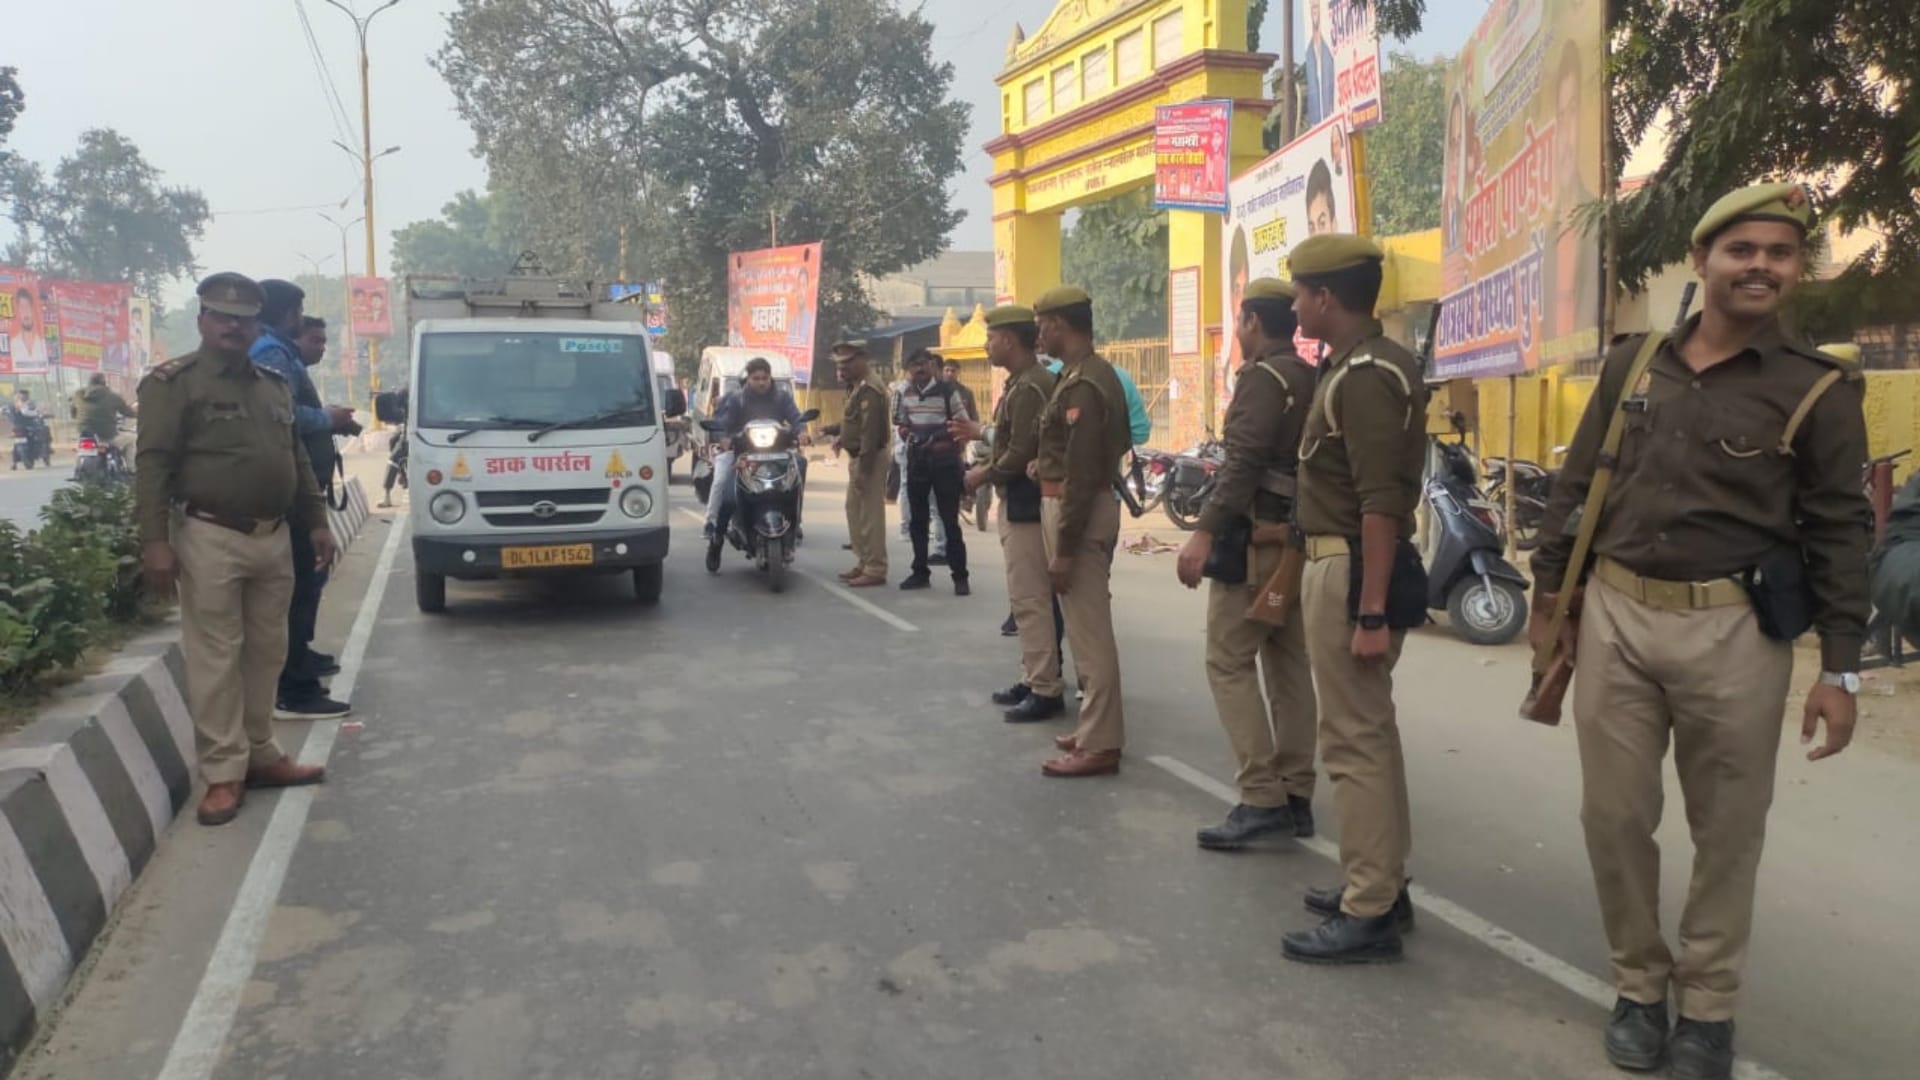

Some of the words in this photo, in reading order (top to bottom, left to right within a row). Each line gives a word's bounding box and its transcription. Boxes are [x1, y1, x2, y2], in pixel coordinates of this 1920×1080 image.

[1501, 119, 1556, 237] पाण्डेय
[1476, 261, 1518, 340] अध्यक्ष
[485, 457, 526, 474] डाक
[532, 451, 592, 473] पार्सल
[510, 547, 592, 564] DL1LAF1542
